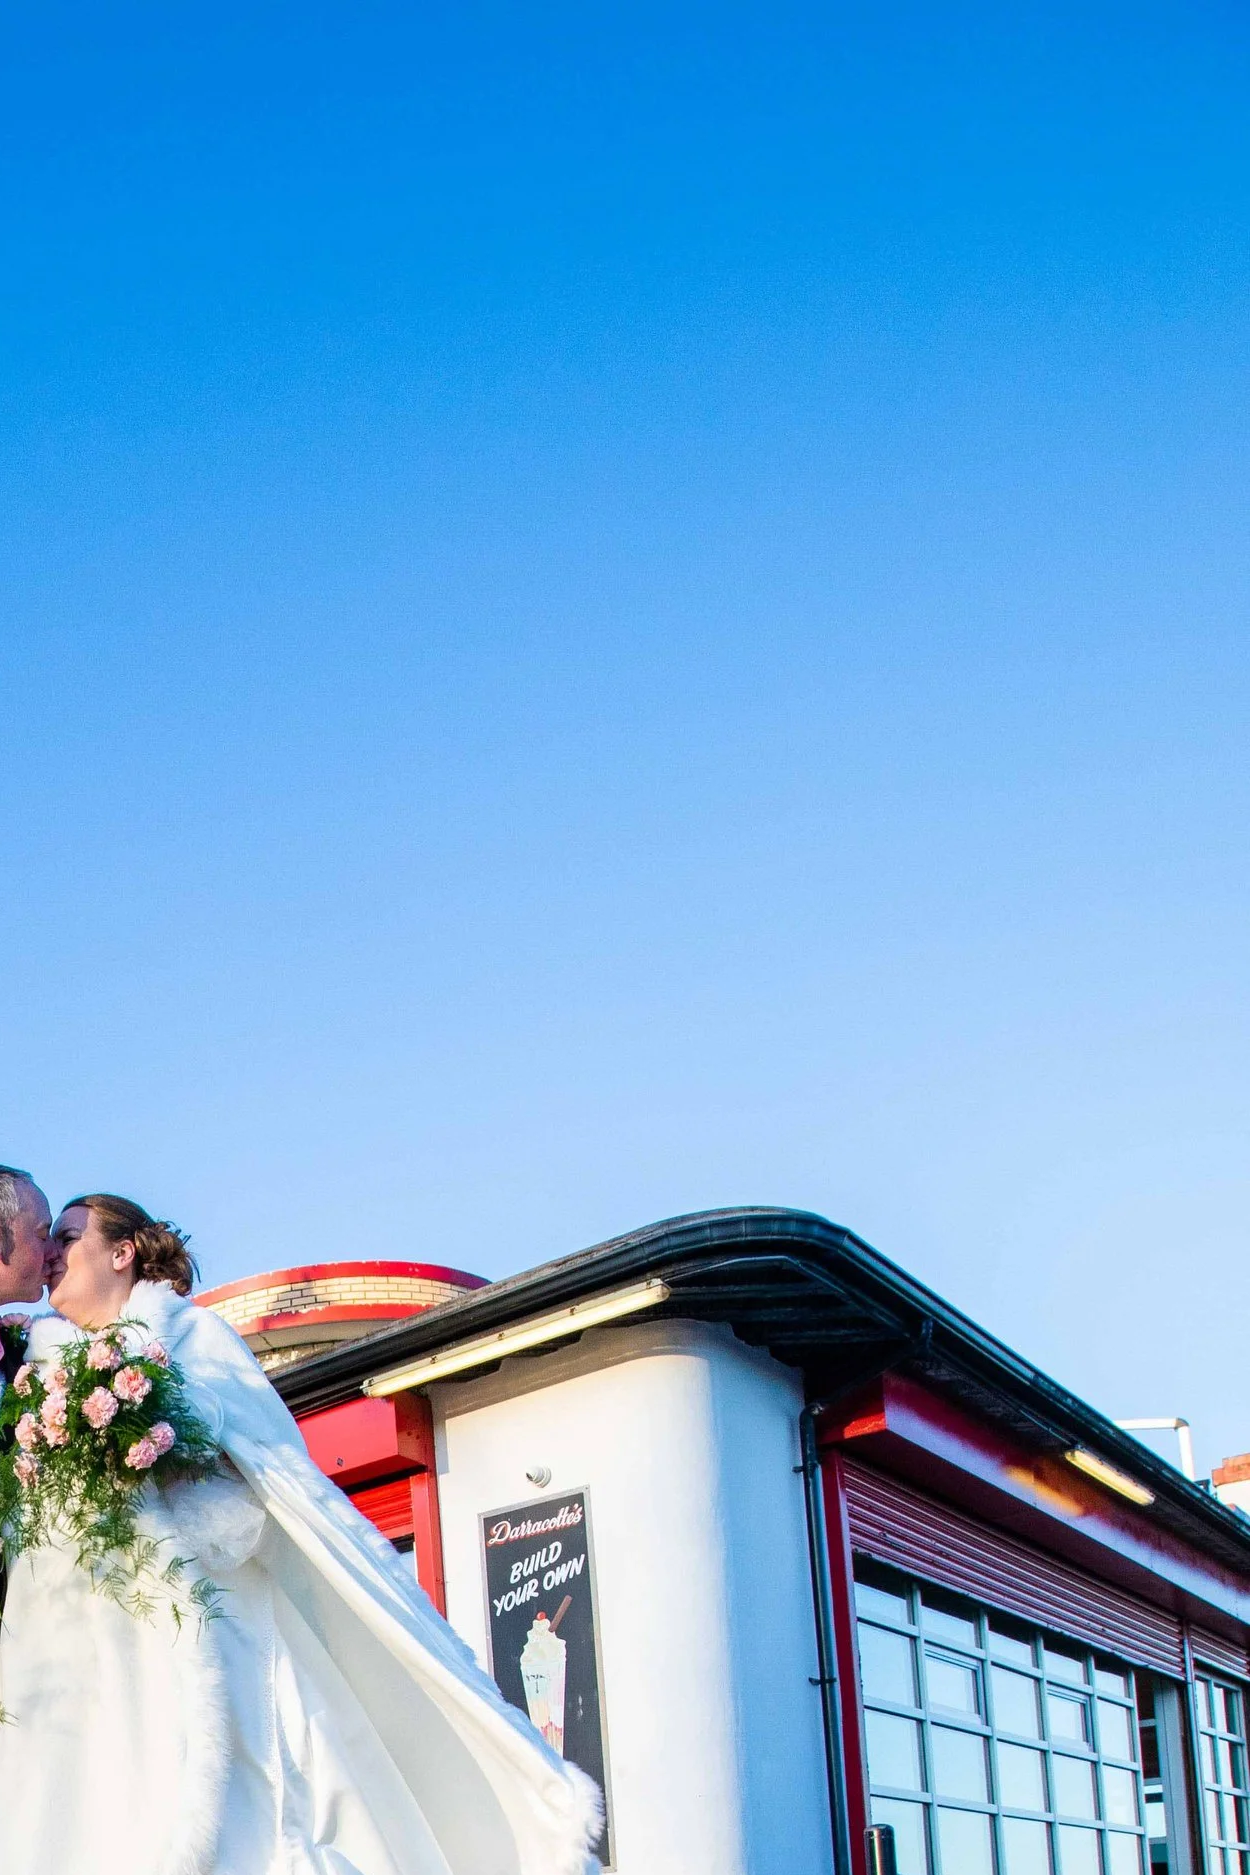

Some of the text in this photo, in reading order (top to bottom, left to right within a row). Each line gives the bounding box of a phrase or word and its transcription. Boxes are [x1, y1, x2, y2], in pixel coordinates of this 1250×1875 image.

[486, 1503, 583, 1547] Darracotte's
[510, 1541, 562, 1584] BUILD
[493, 1554, 585, 1617] YOUR OWN
